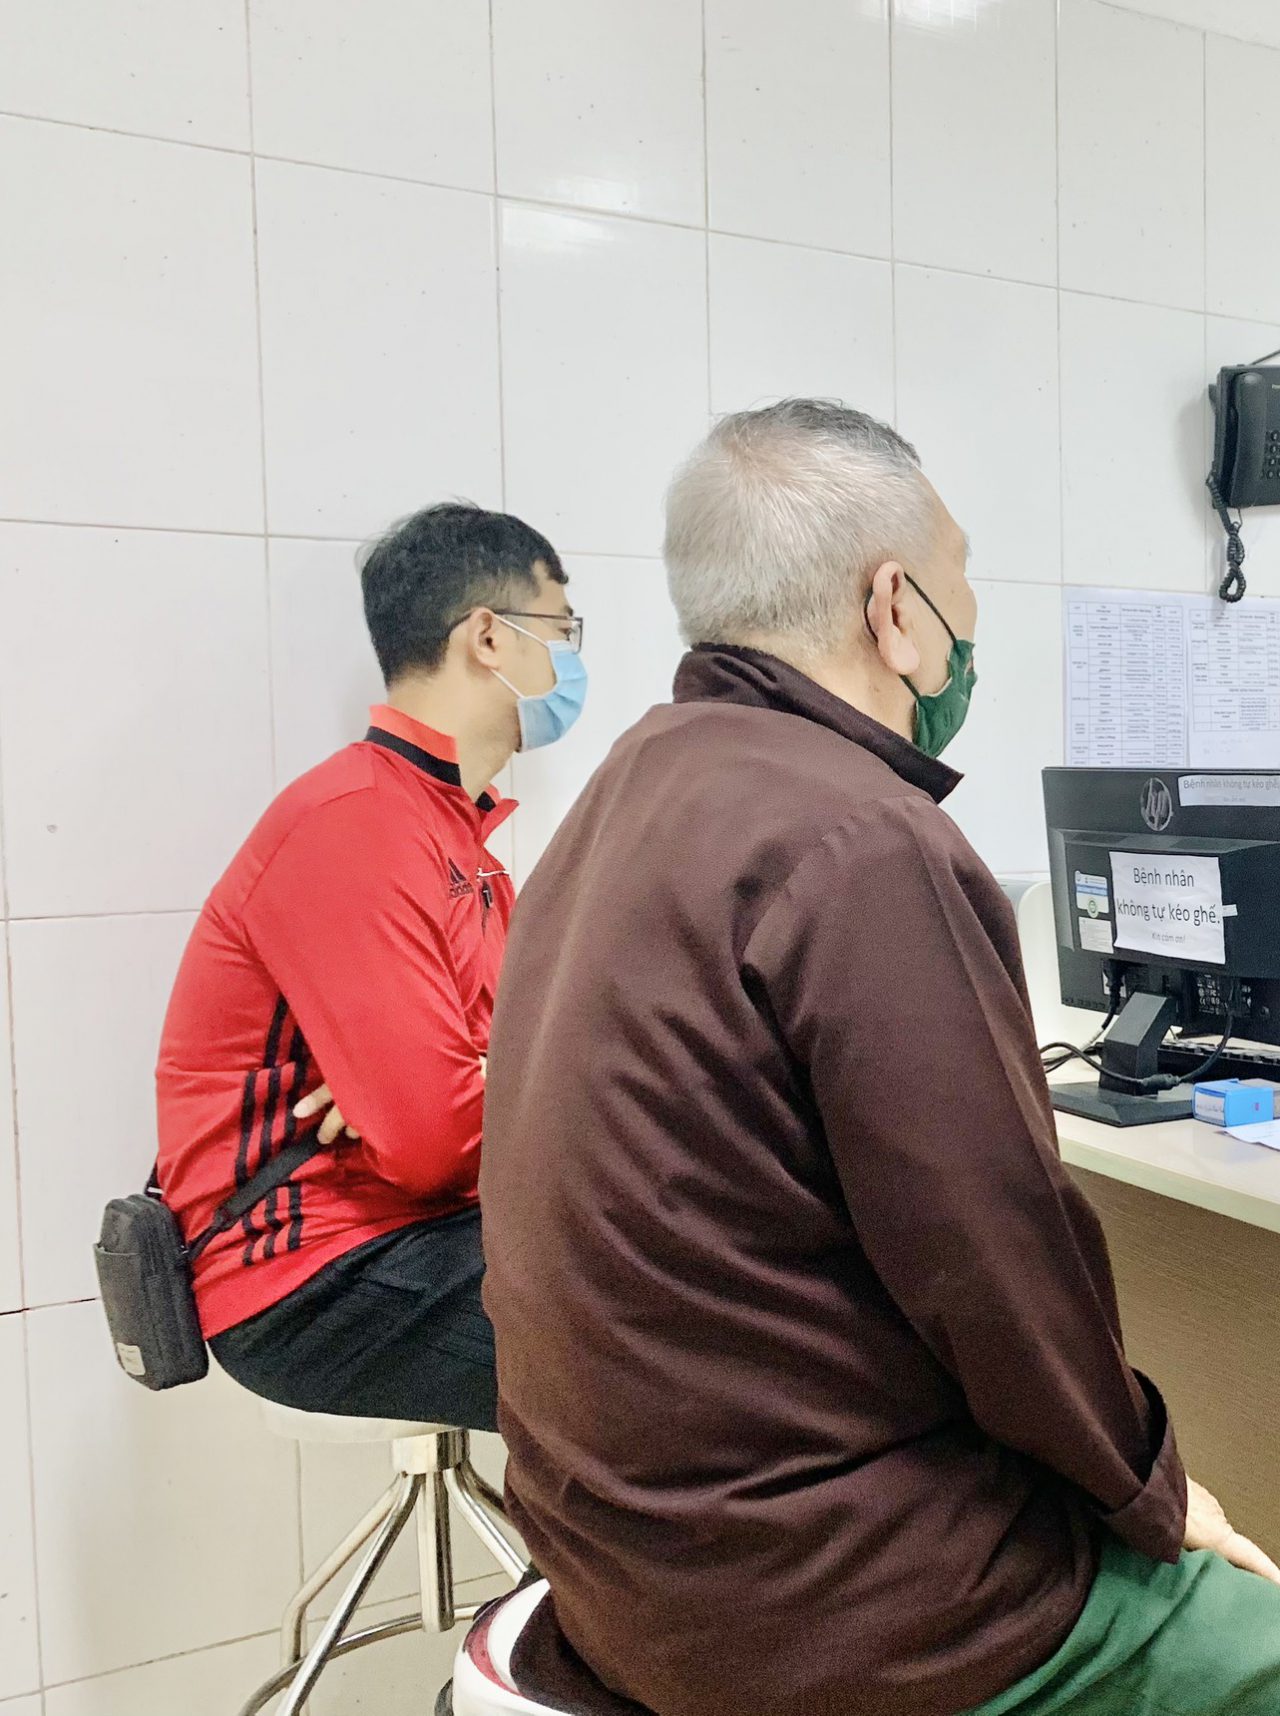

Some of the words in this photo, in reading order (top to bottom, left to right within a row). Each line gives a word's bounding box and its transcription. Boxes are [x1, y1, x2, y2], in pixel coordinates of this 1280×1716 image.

[1133, 866, 1161, 886] Bệnh
[1165, 868, 1194, 887] nhân
[1116, 898, 1150, 921] không
[1151, 904, 1165, 921] tự
[1168, 902, 1190, 921] kéo
[1193, 904, 1220, 926] ghế.
